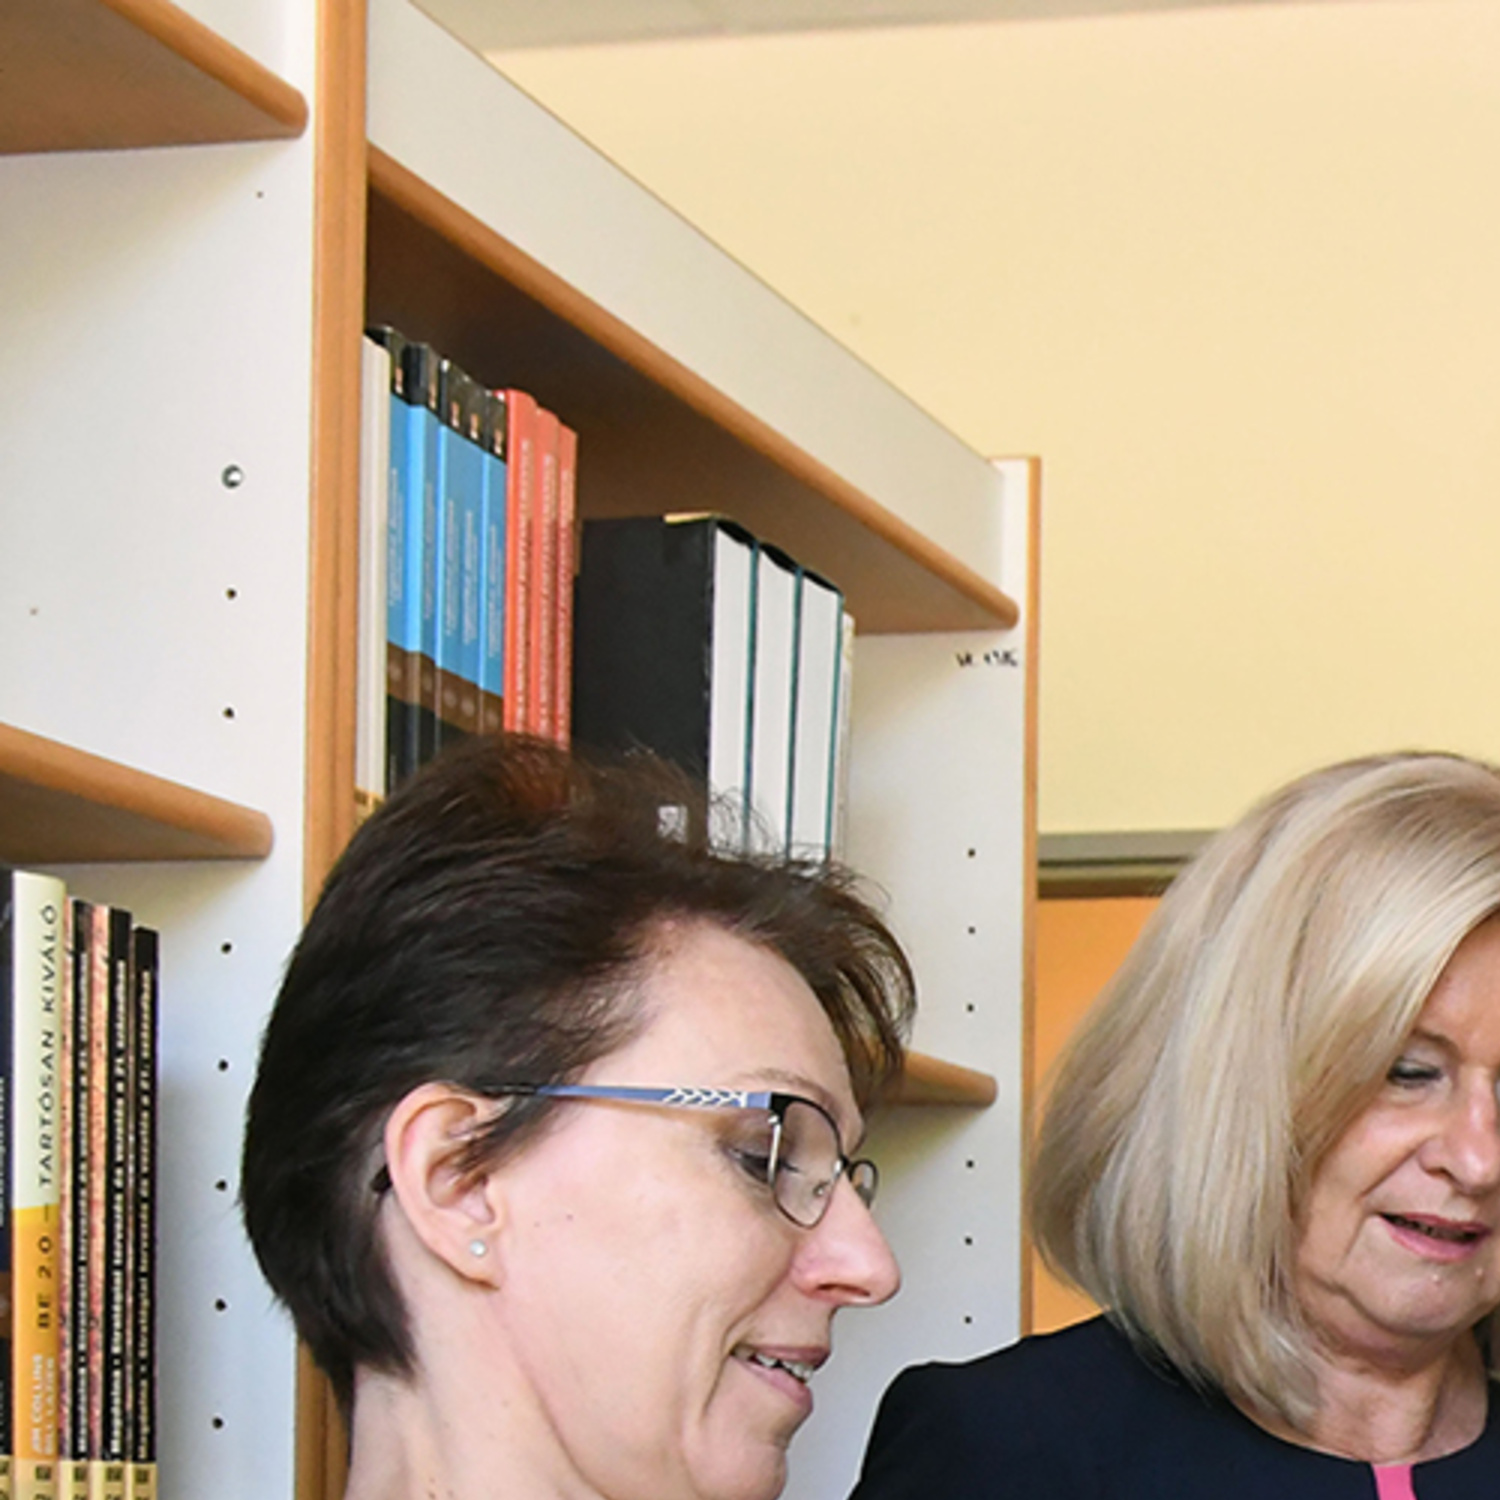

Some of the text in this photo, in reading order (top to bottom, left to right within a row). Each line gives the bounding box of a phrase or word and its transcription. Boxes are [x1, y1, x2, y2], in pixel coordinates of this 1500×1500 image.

[40, 904, 56, 1013] KIVÁLÓ
[38, 1030, 55, 1187] TARTÓSAN
[37, 1236, 52, 1279] 2.0
[37, 1293, 52, 1329] BE
[31, 1354, 44, 1455] JIM COLLINS
[45, 1425, 56, 1456] BILL
